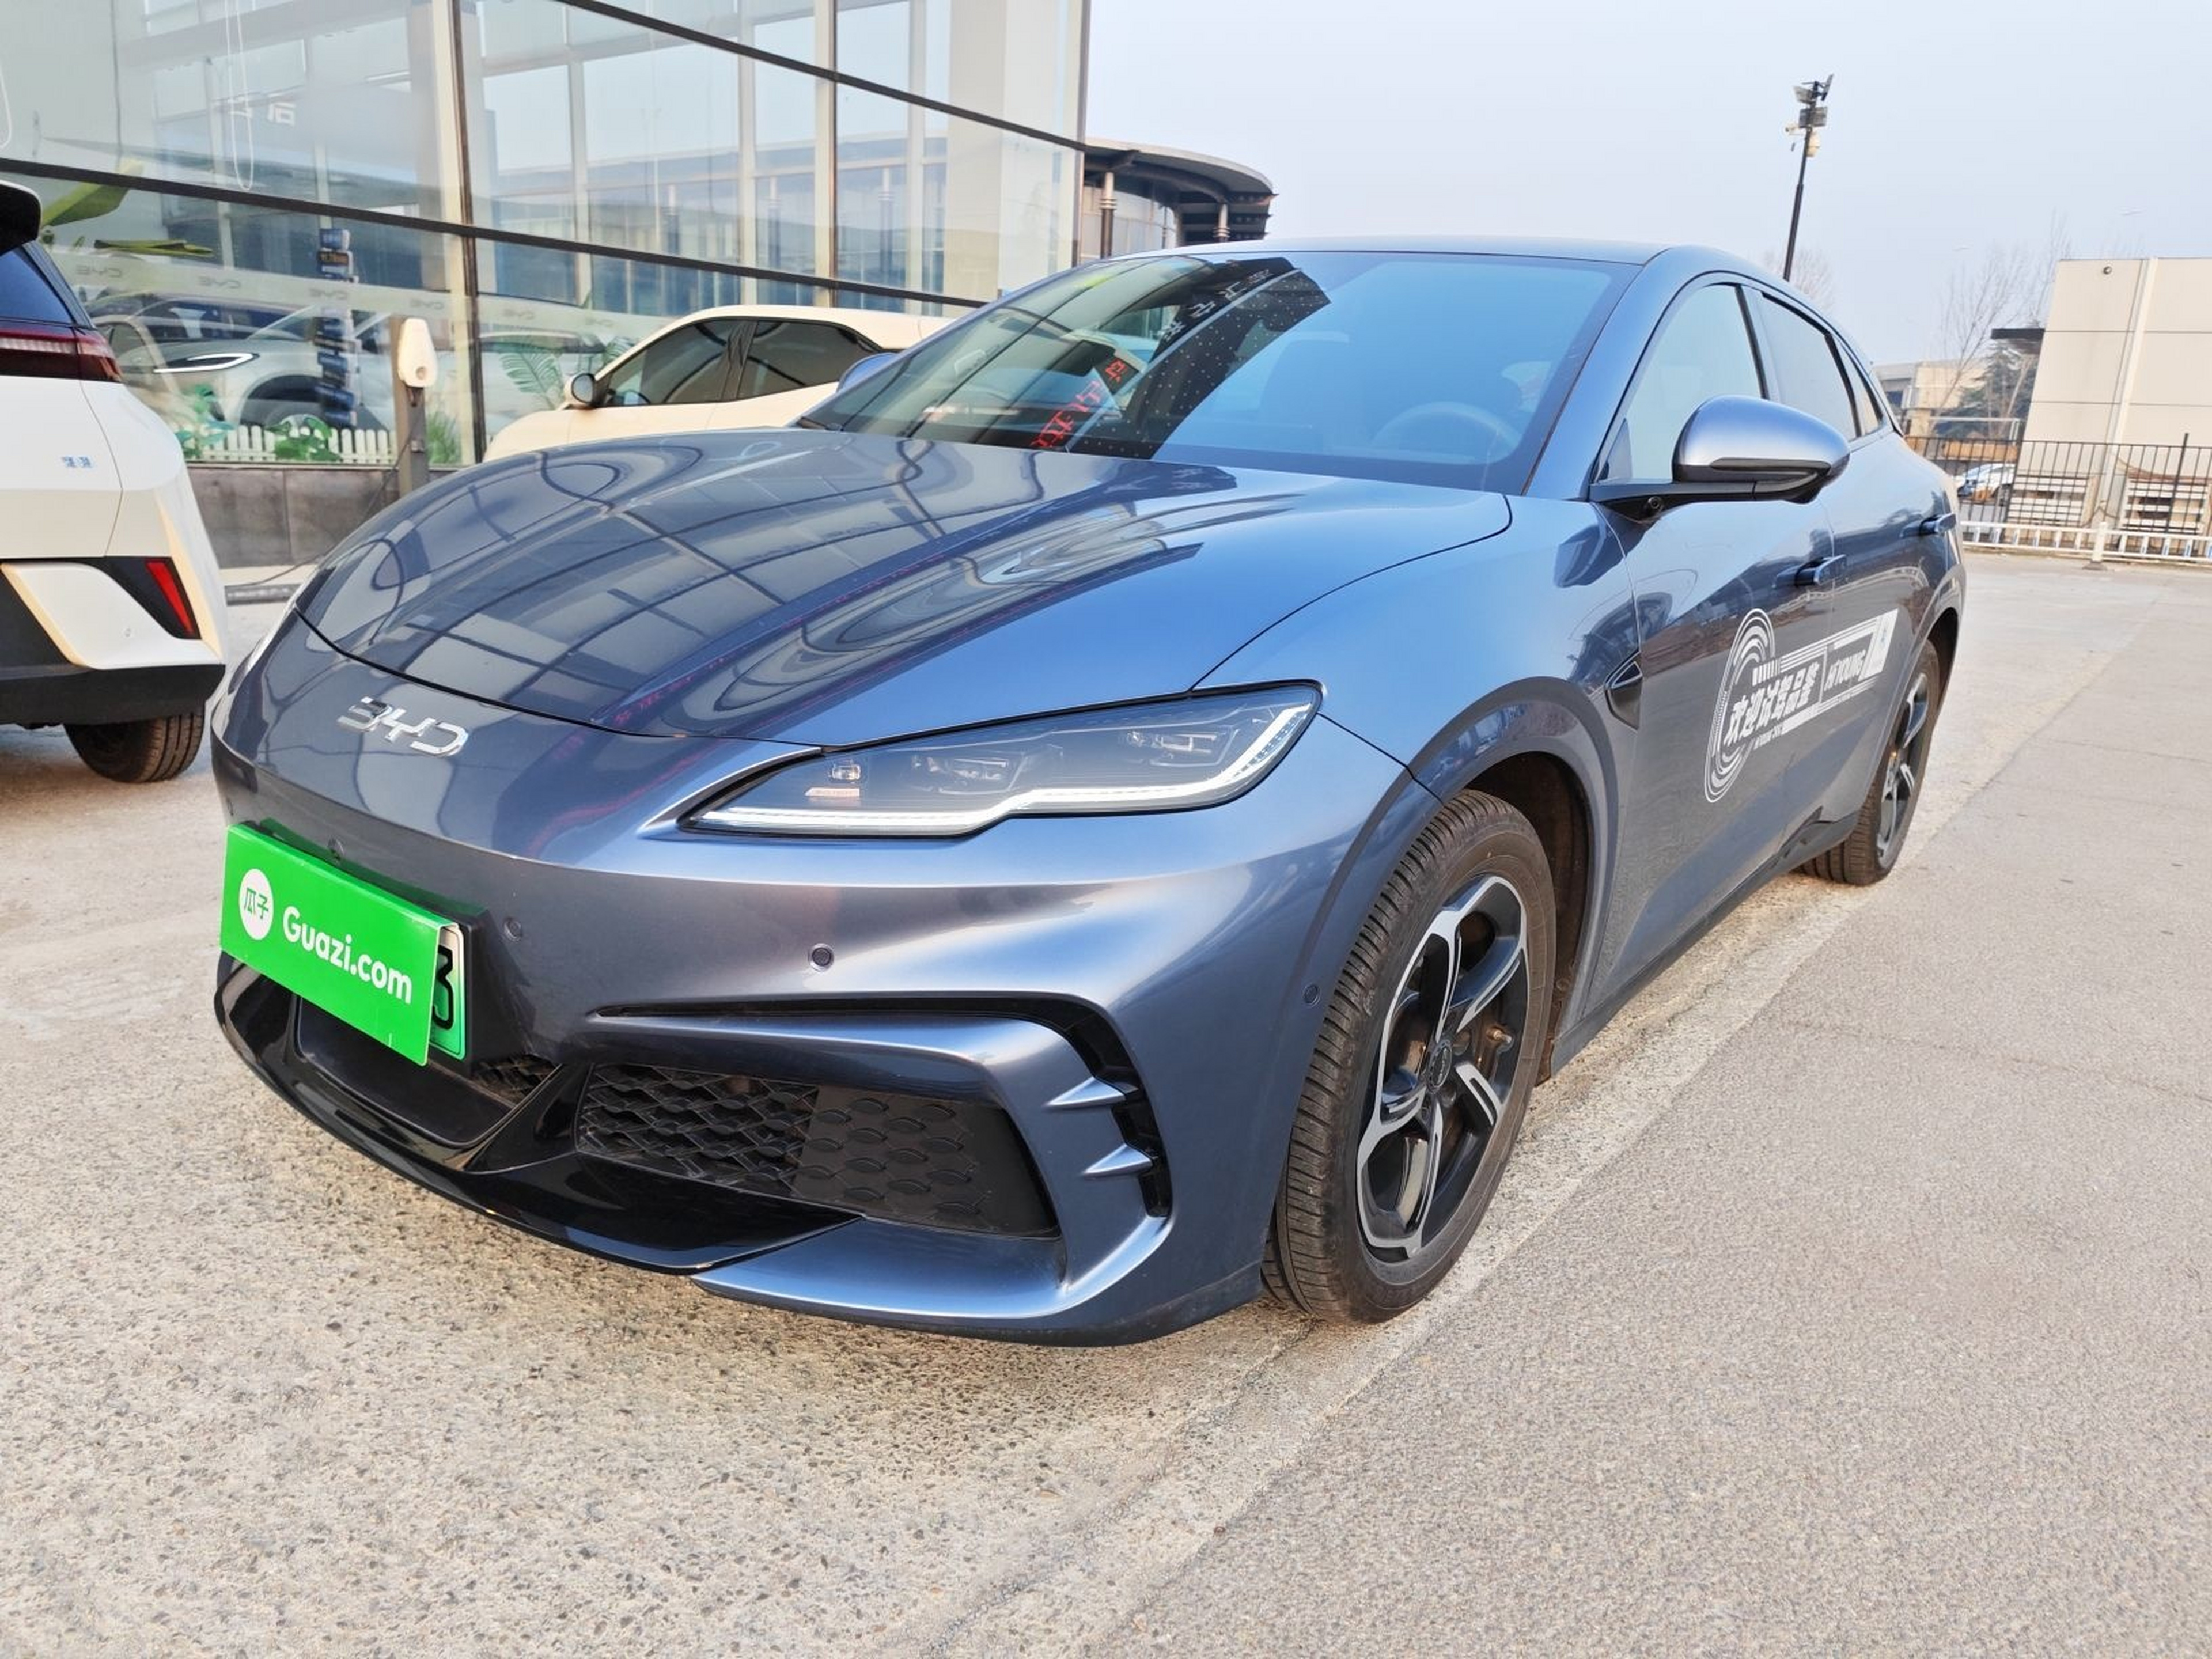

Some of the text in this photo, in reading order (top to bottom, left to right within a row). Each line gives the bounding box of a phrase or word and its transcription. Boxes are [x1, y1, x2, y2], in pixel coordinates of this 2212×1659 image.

[75, 264, 123, 278] BYD
[336, 696, 469, 757] BYD
[244, 887, 269, 920] 瓜子
[282, 905, 412, 1005] Guazi.com
